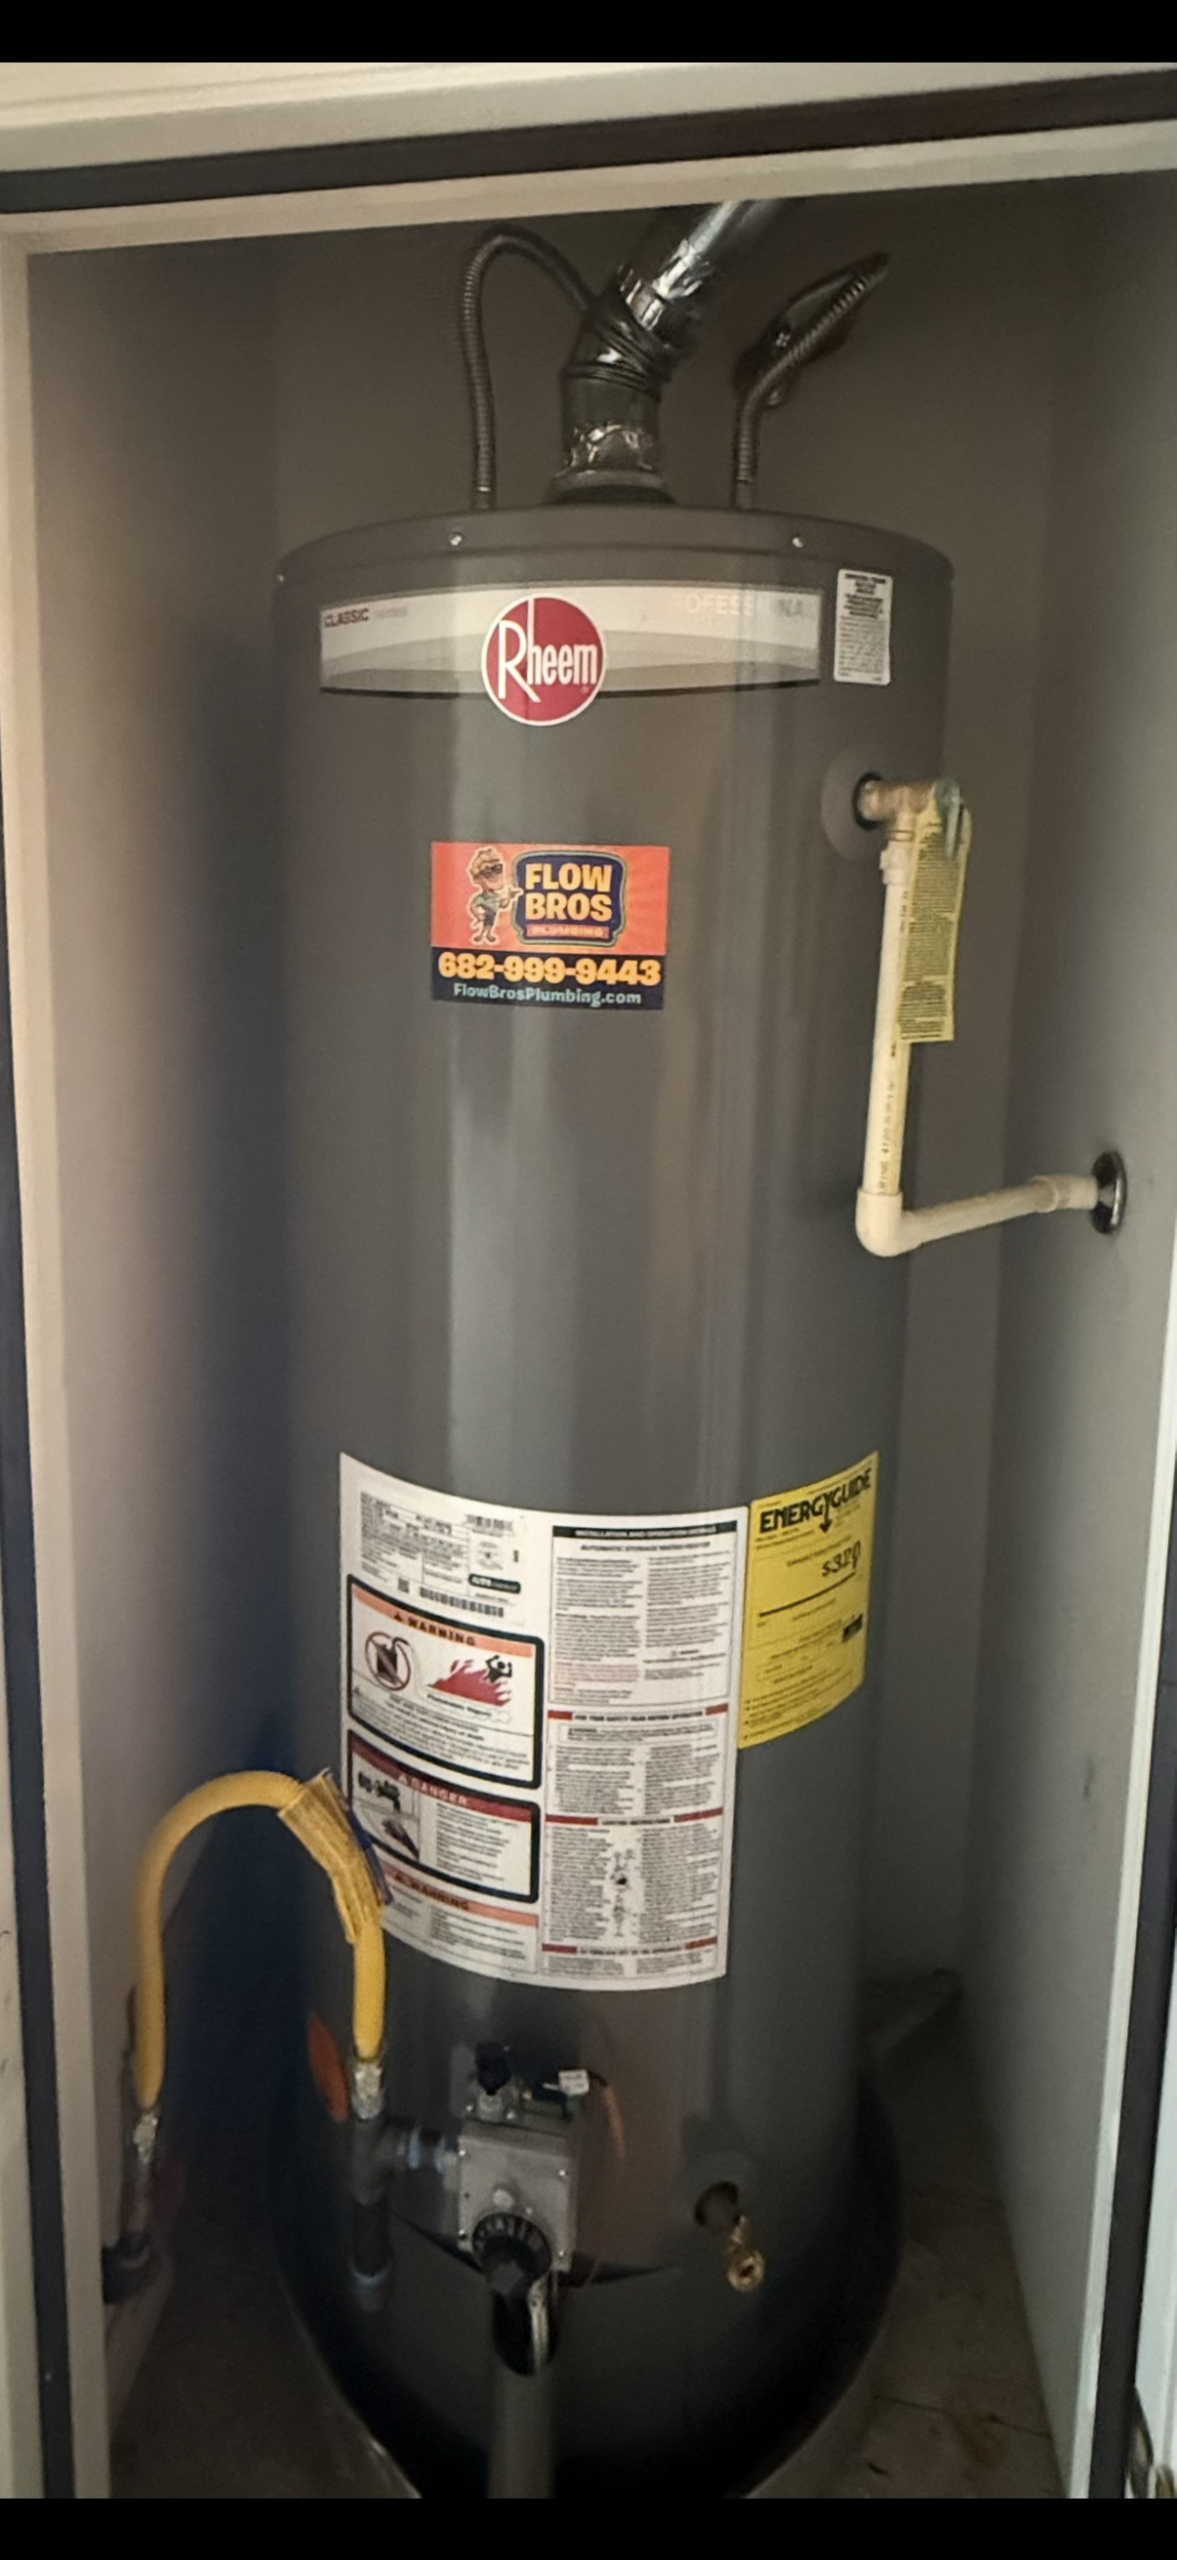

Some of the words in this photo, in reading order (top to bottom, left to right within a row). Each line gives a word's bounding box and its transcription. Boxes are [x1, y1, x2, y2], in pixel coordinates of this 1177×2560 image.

[324, 607, 369, 628] CLASSIC
[498, 597, 598, 702] Rheem
[525, 863, 612, 892] FLOW
[525, 892, 612, 922] BROS
[438, 951, 661, 986] 682-999-9443
[453, 983, 642, 1008] FlowBrosPlumbing.com
[408, 1617, 476, 1647] WARNING
[407, 1877, 470, 1911] WARNING
